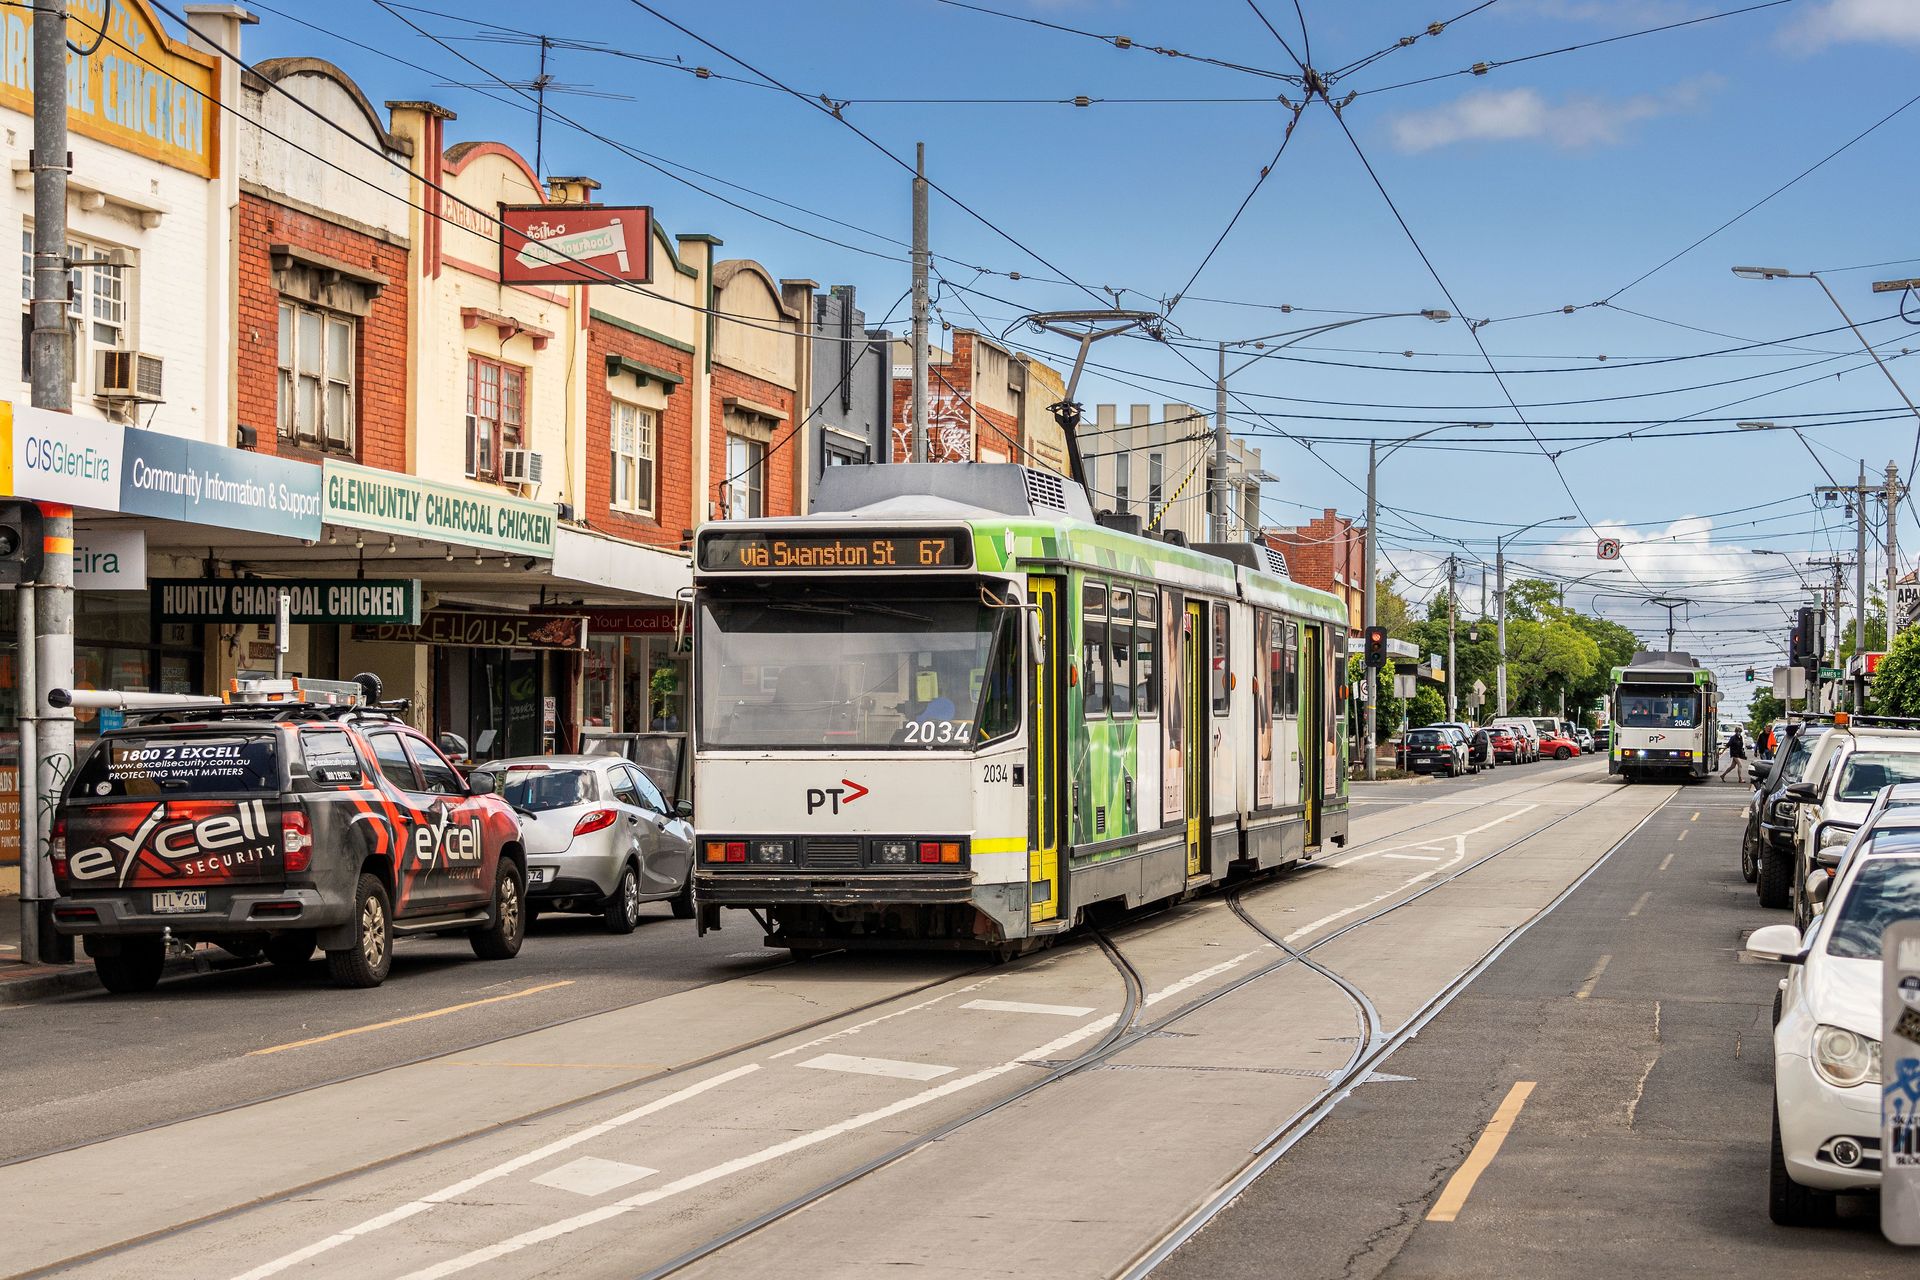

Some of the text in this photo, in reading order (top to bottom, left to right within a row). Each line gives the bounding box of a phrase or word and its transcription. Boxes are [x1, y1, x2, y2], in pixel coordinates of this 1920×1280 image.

[102, 54, 203, 156] CHICKEN
[25, 436, 110, 483] CISGlenEira
[133, 457, 321, 520] Community Information & Support
[328, 474, 551, 545] GLENHUNTLY CHARCOAL CHICKEN
[740, 540, 946, 566] via Swanston St 67
[163, 585, 227, 615] HUNTLY
[328, 585, 404, 616] CHICKEN
[1897, 588, 1920, 603] APA
[377, 612, 534, 646] BAKEHOUSE
[594, 615, 624, 628] Your
[627, 615, 659, 628] Local
[903, 720, 970, 744] 2034
[108, 757, 251, 771] www.excellsecurity.com.au
[121, 746, 242, 762] 1800 2 EXCELL
[108, 766, 244, 781] PROTECTING WHAT MATTERS
[983, 764, 1008, 783] 2034
[185, 844, 277, 876] SECURITY
[184, 892, 206, 906] 2GW
